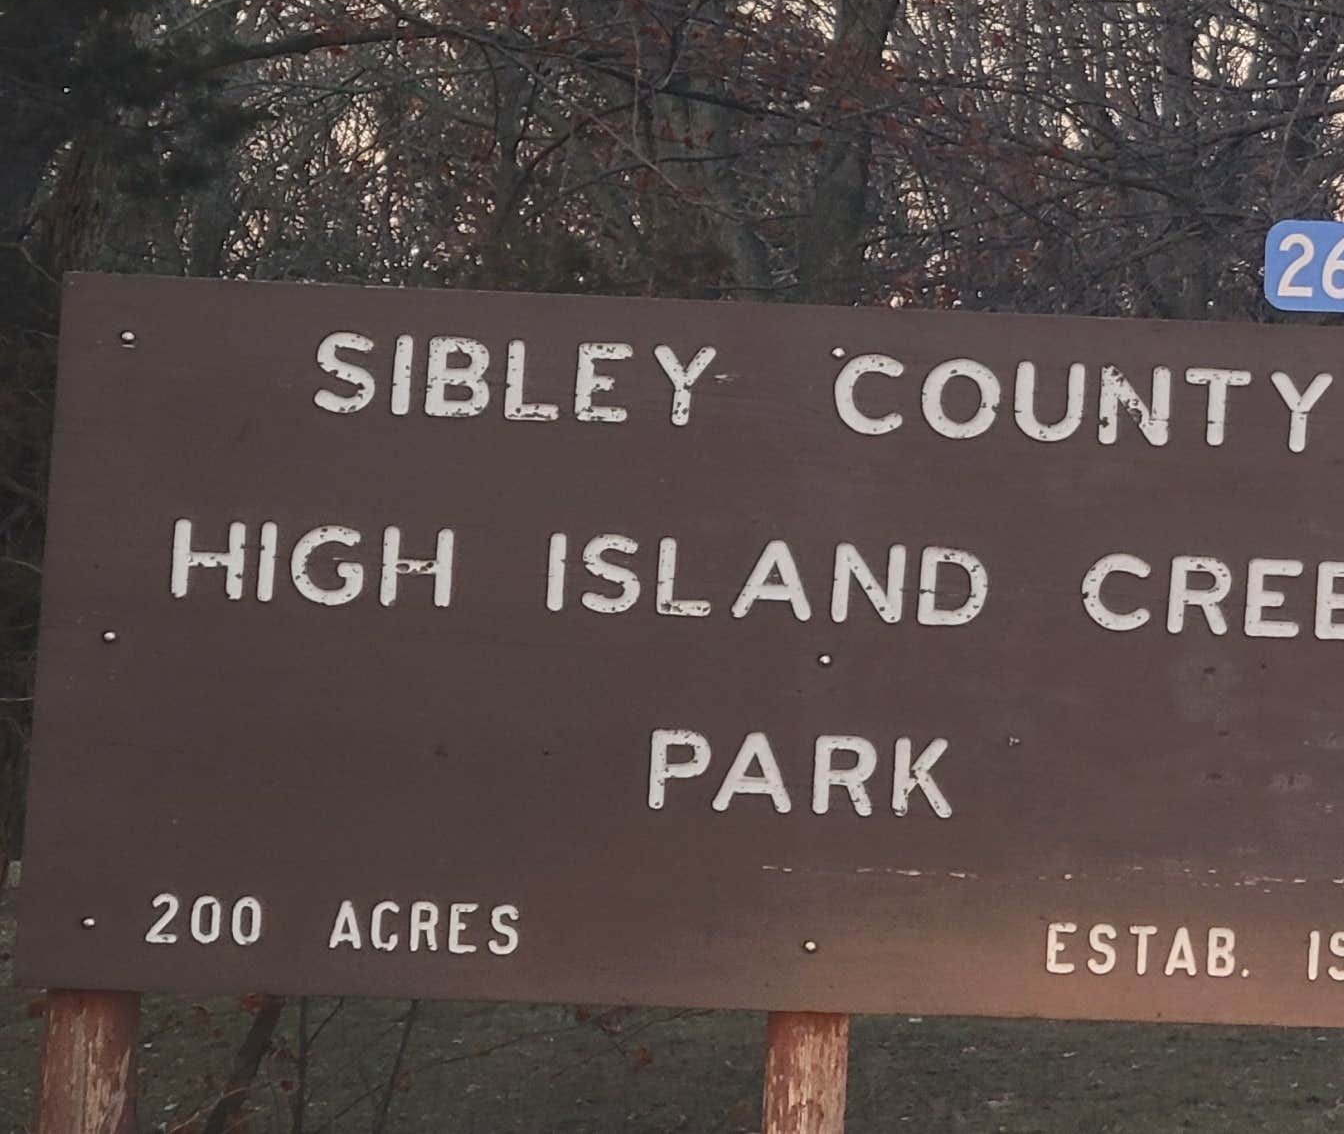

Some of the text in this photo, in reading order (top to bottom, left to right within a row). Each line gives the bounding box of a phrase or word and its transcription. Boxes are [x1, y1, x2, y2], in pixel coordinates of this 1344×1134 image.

[314, 330, 1333, 453] SIBLEY COUNTY
[170, 517, 455, 608] HIGH
[546, 531, 989, 627] ISLAND
[648, 728, 952, 820] PARK
[145, 893, 520, 956] 200 ACRES
[1046, 921, 1251, 979] ESTAB.
